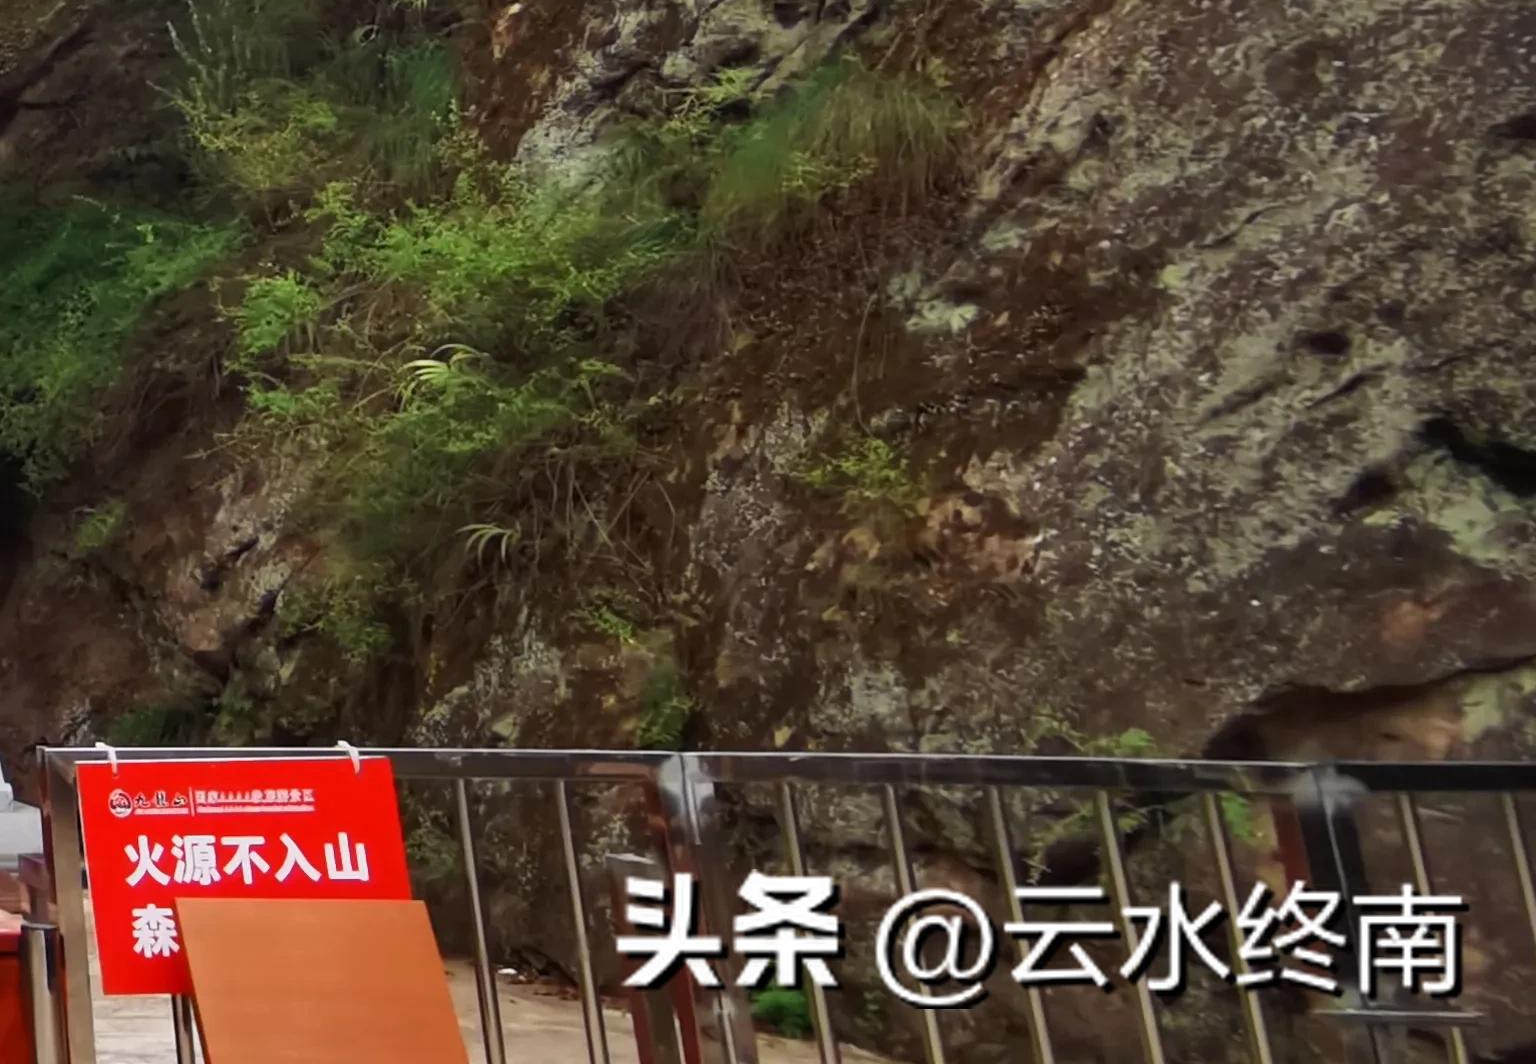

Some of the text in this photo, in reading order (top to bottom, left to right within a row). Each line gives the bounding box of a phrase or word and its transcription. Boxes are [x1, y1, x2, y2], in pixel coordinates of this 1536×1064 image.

[124, 832, 370, 887] 火源不入山
[132, 903, 180, 958] 森
